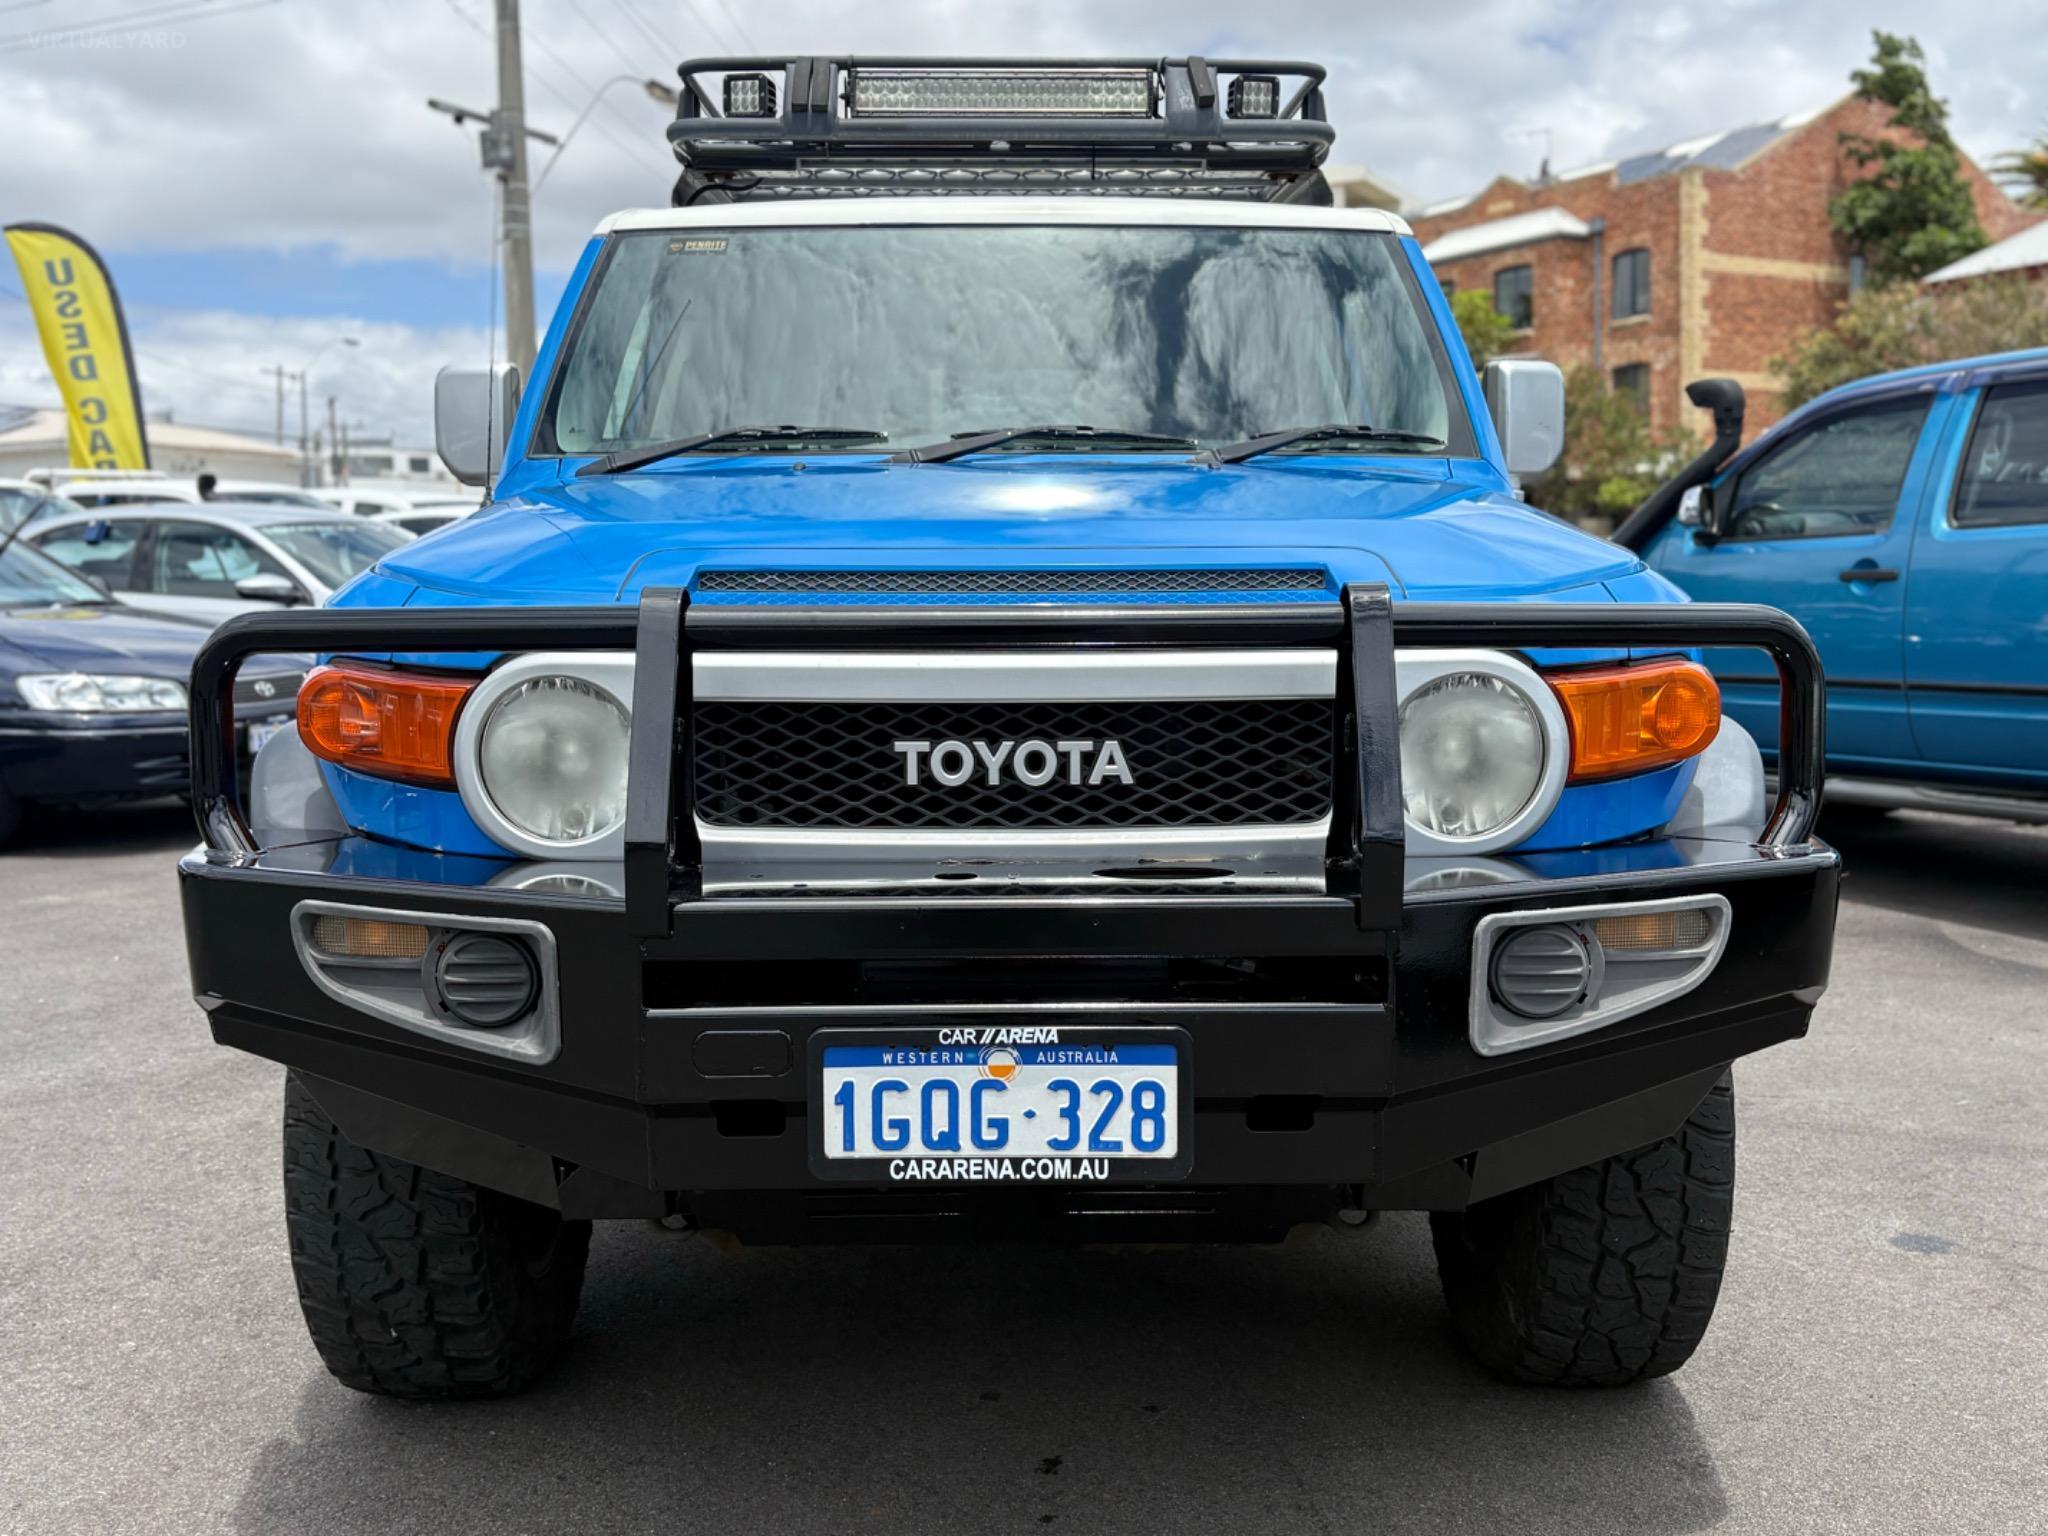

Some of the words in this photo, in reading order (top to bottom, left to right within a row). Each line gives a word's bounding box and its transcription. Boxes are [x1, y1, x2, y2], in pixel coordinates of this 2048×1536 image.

[684, 240, 726, 250] PENRITE
[894, 740, 1134, 786] TOYOTA
[882, 1052, 964, 1064] WESTERN
[1036, 1051, 1119, 1064] AUSTRALIA
[889, 1158, 1109, 1180] CARARENA.COM.AU
